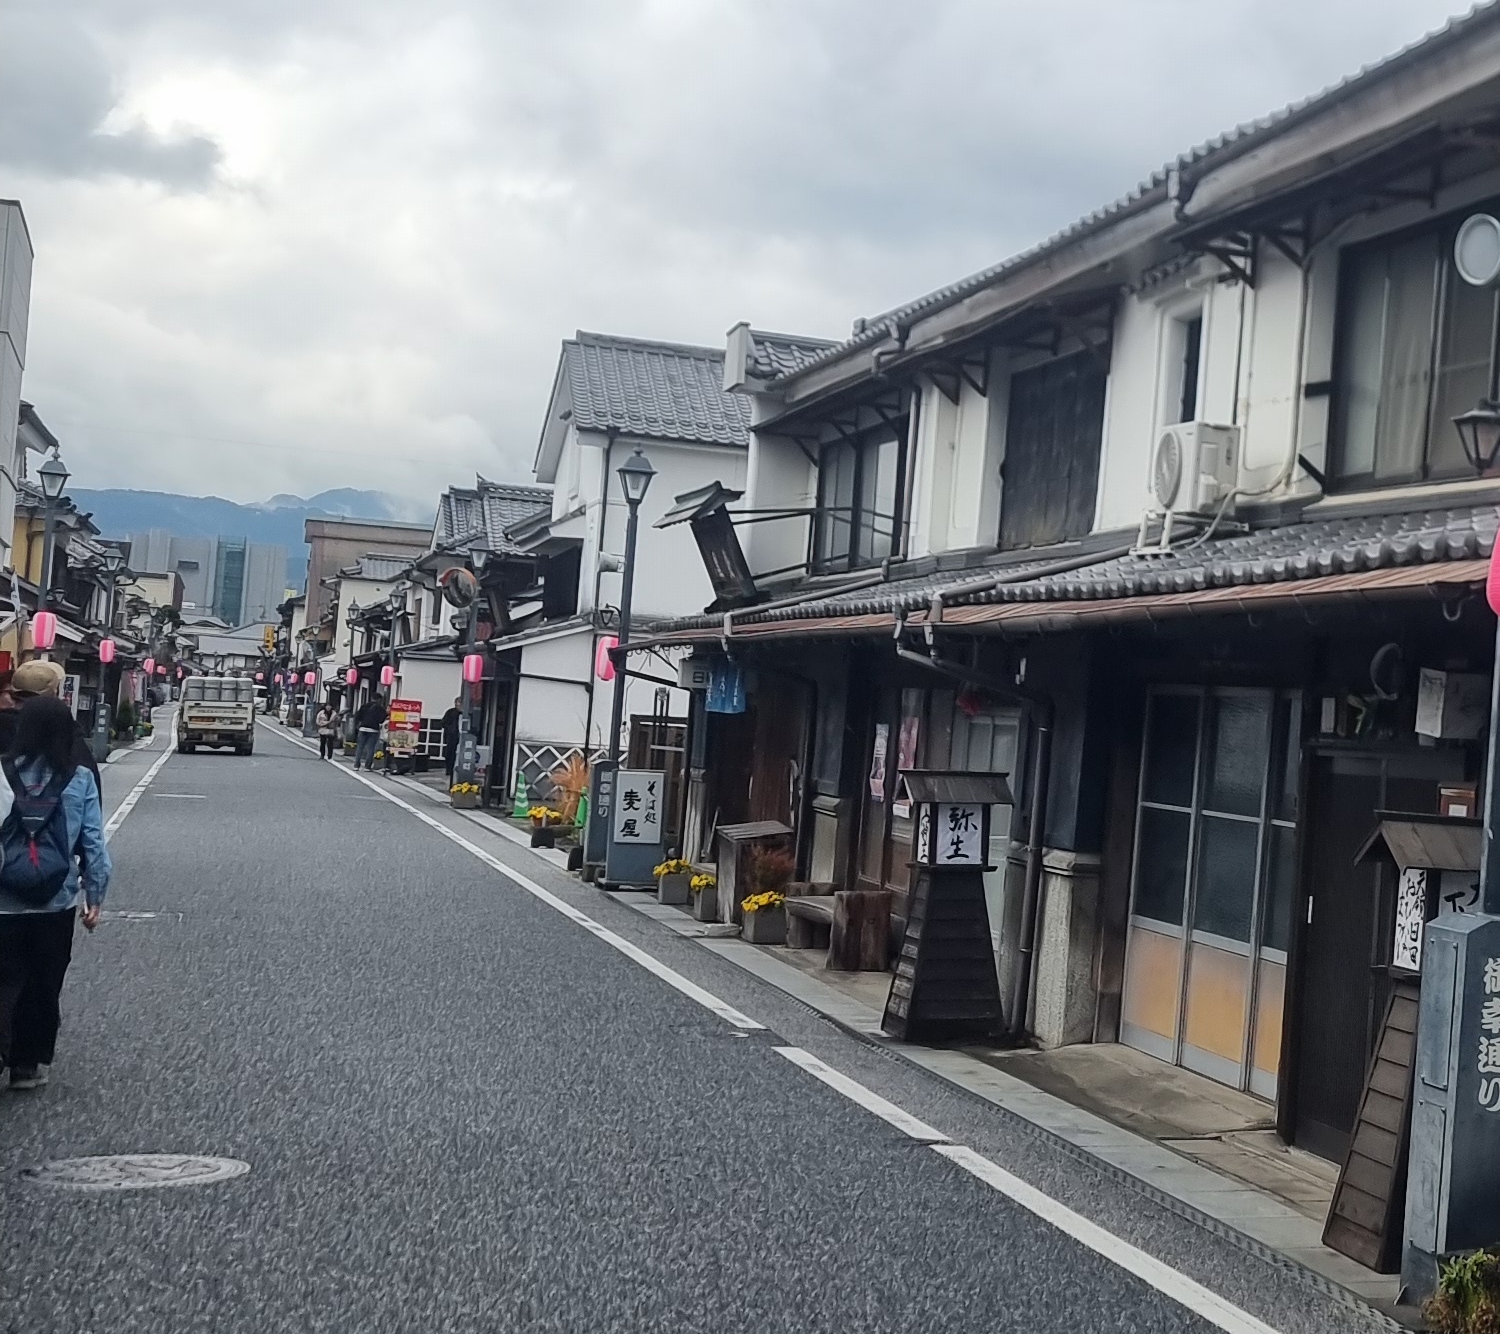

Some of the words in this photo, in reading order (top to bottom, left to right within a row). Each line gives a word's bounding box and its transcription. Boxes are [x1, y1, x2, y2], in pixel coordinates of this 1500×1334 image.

[620, 789, 642, 838] 麦屋
[643, 780, 657, 824] そば処
[946, 807, 979, 860] 弥生
